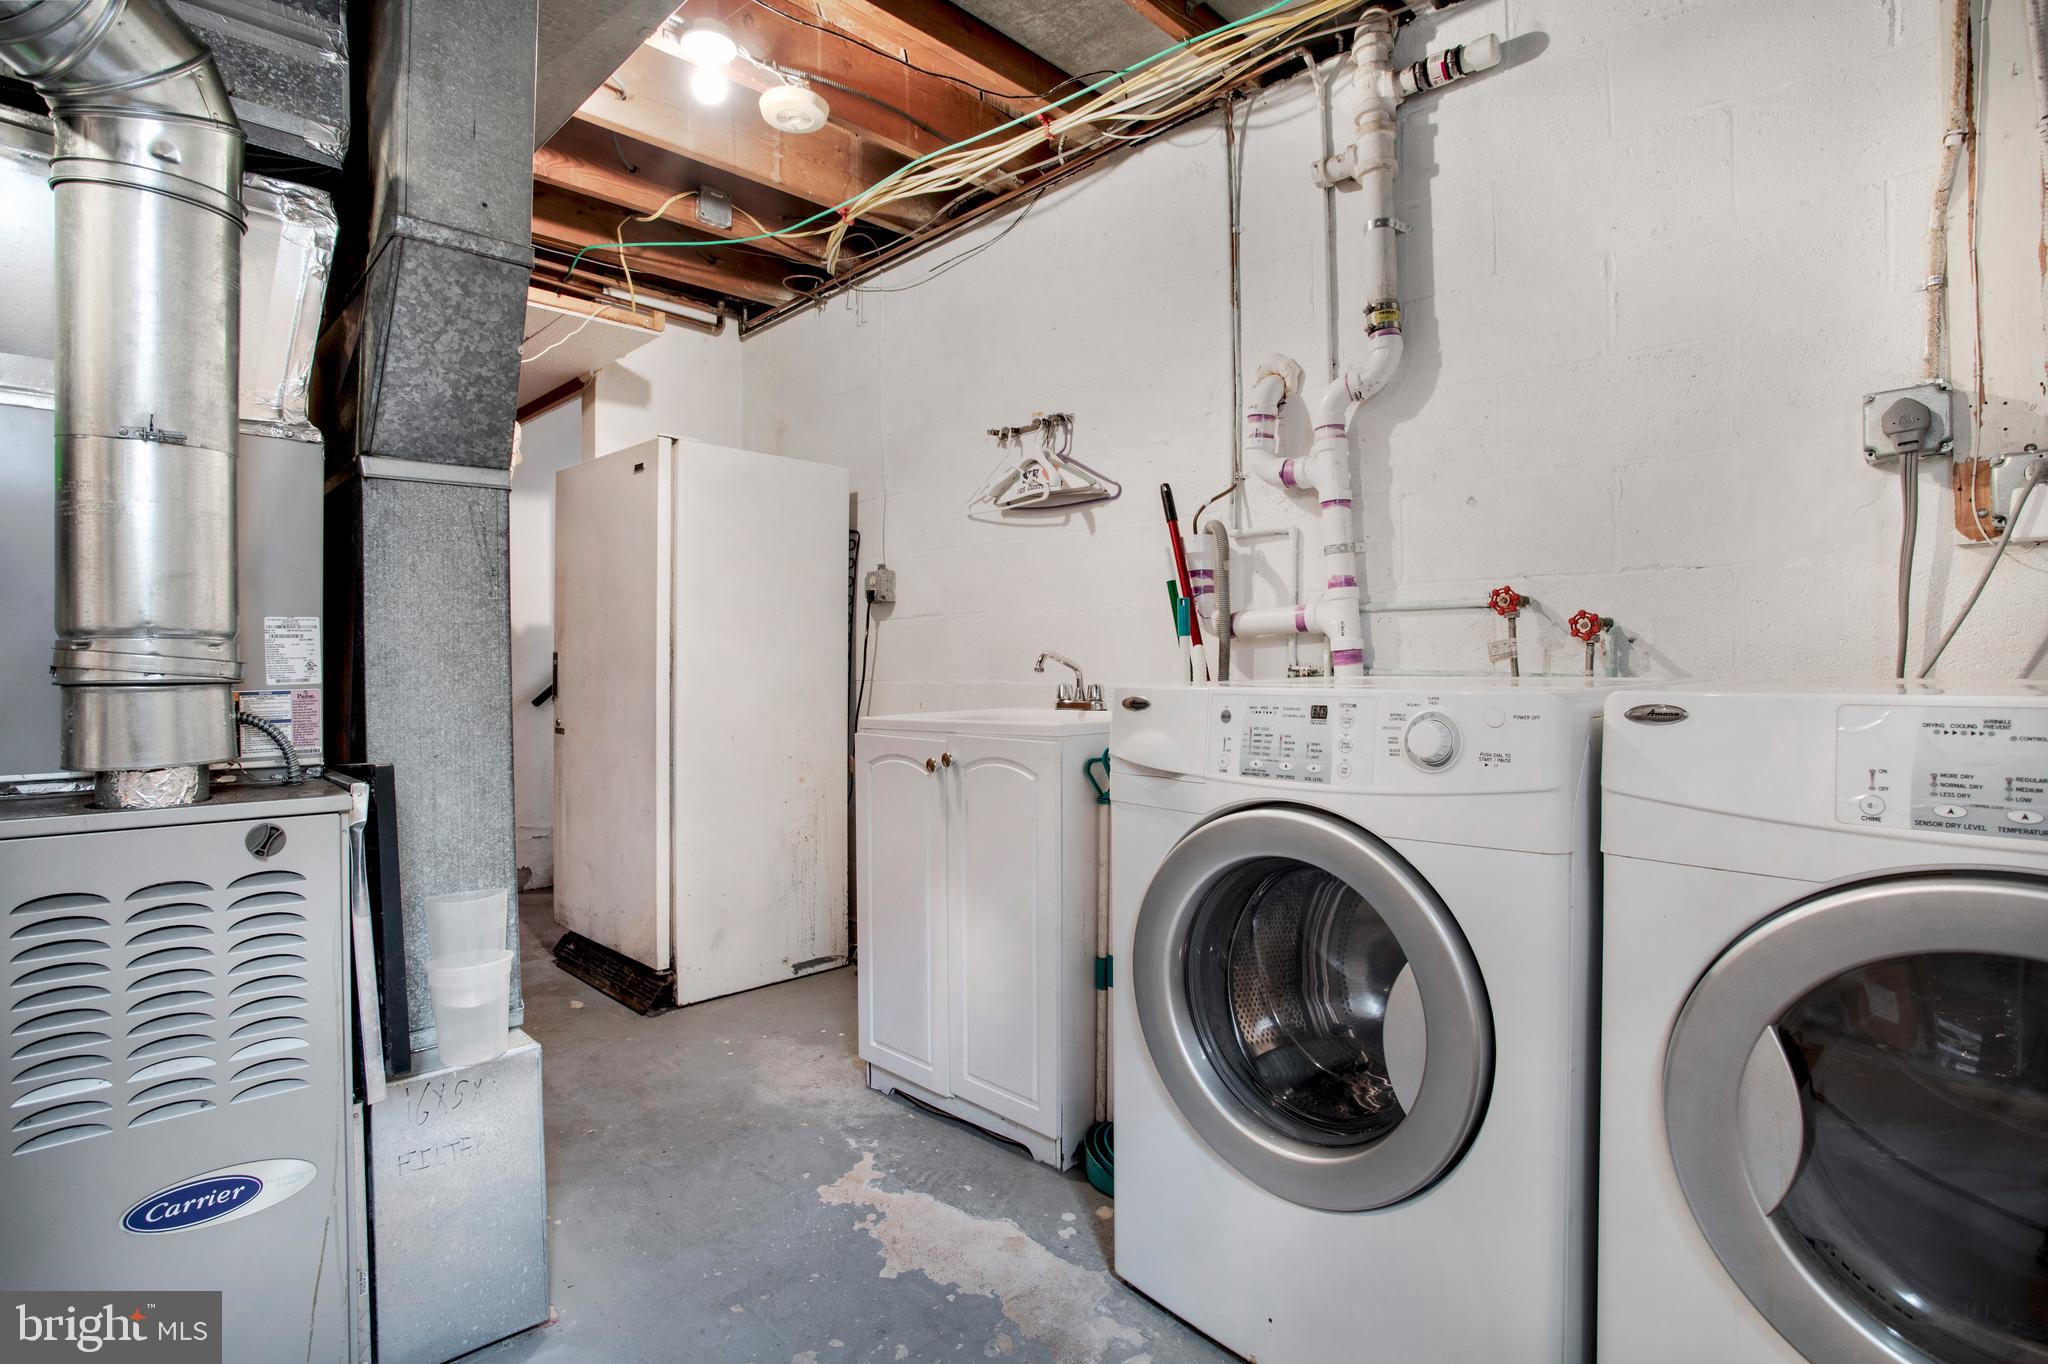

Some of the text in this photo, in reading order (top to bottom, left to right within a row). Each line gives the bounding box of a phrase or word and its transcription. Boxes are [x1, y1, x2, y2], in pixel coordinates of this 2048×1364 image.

[1647, 709, 1680, 717] Amana
[1940, 782, 1967, 790] NORMAL
[2015, 786, 2044, 794] MEDIUM
[1914, 819, 1987, 832] SENSOR DRY LEVEL
[145, 1184, 246, 1223] Carrier
